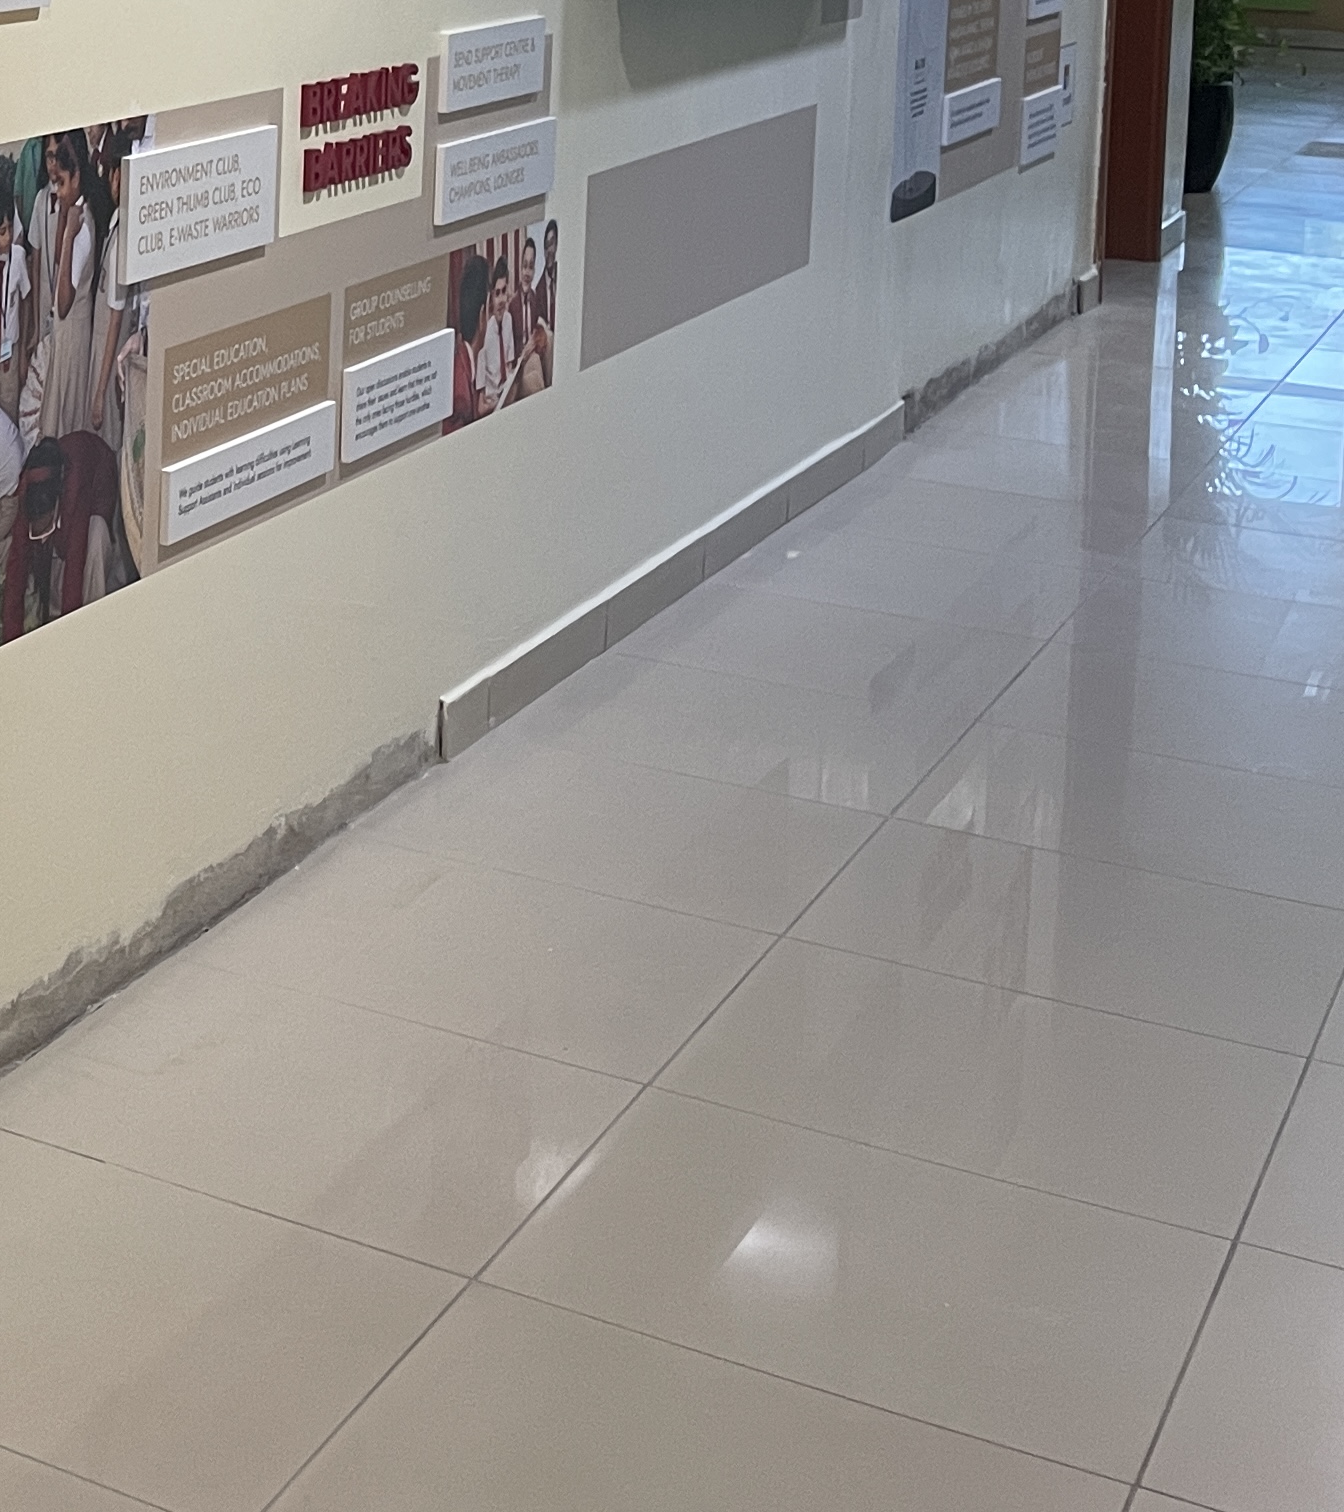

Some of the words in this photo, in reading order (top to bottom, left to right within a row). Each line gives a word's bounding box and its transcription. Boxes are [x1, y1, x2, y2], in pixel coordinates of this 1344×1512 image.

[300, 63, 420, 128] BREAKING
[139, 158, 214, 196] ENVIRONMENT
[215, 152, 241, 176] CLUB,
[303, 125, 413, 193] BARRIERS
[138, 198, 174, 225] GREEN
[175, 189, 210, 214] THUMB
[211, 184, 238, 206] CLUB,
[240, 178, 261, 199] ECO
